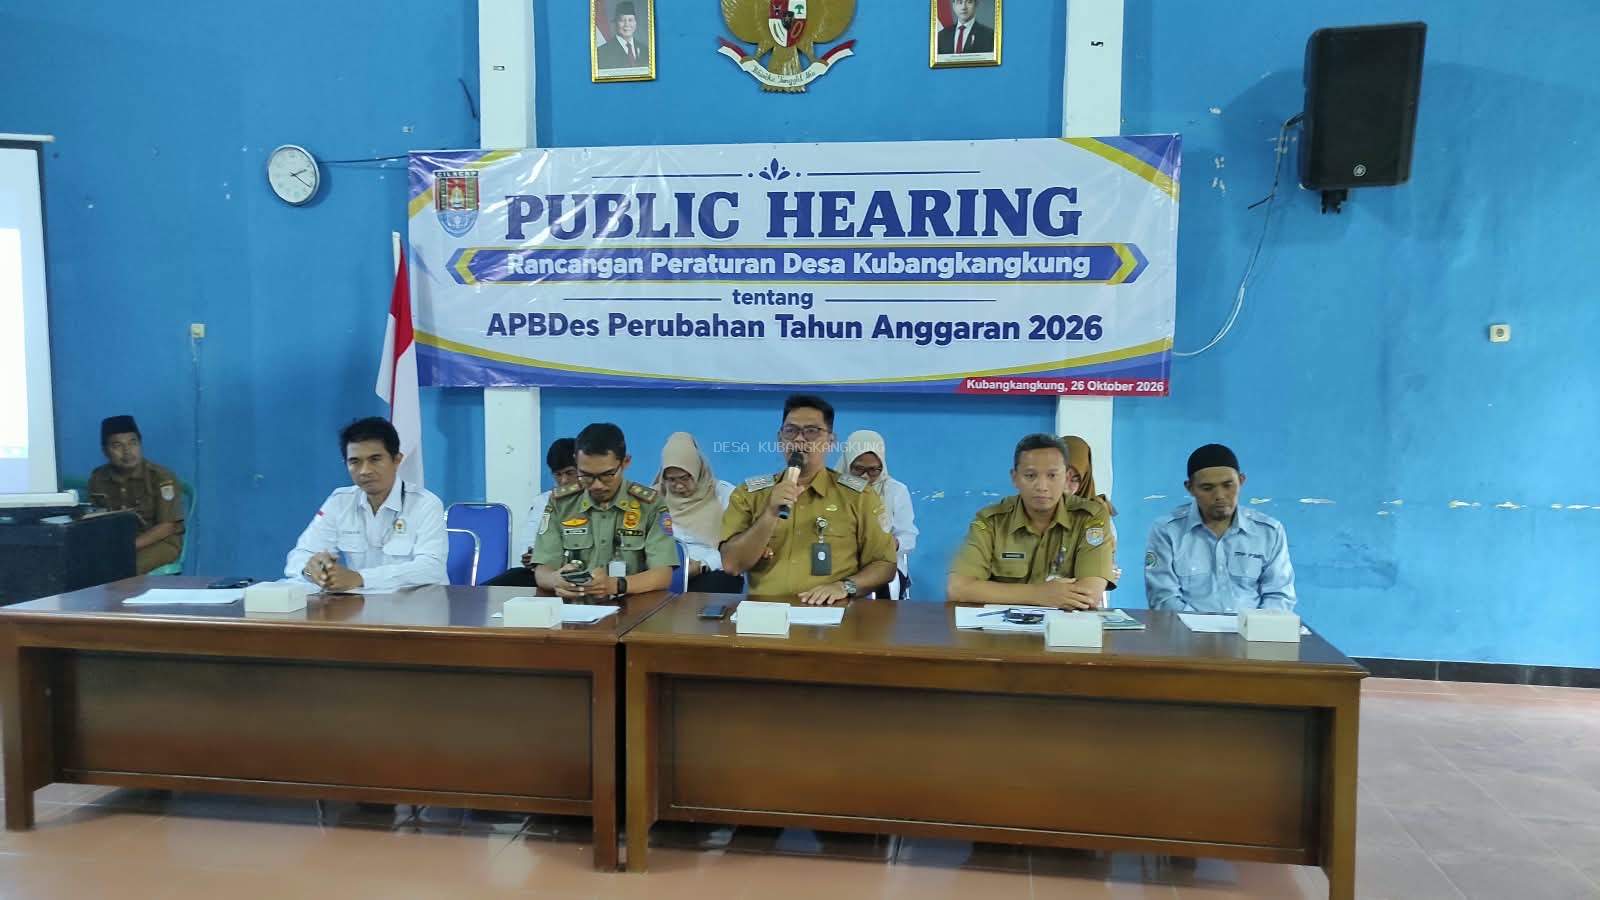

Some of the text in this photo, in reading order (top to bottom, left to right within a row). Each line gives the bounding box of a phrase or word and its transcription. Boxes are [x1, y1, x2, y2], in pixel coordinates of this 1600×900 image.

[505, 192, 739, 240] PUBLIC
[766, 187, 1082, 239] HEARING
[507, 252, 1090, 279] Rancangan Peraturan Desa Kubangkangkung
[733, 289, 814, 310] tentang
[488, 313, 1102, 346] APBDes Perubahan Tahun Anggaran 2026
[967, 380, 1164, 393] Kubangkangkung, 26 Oktober 2026
